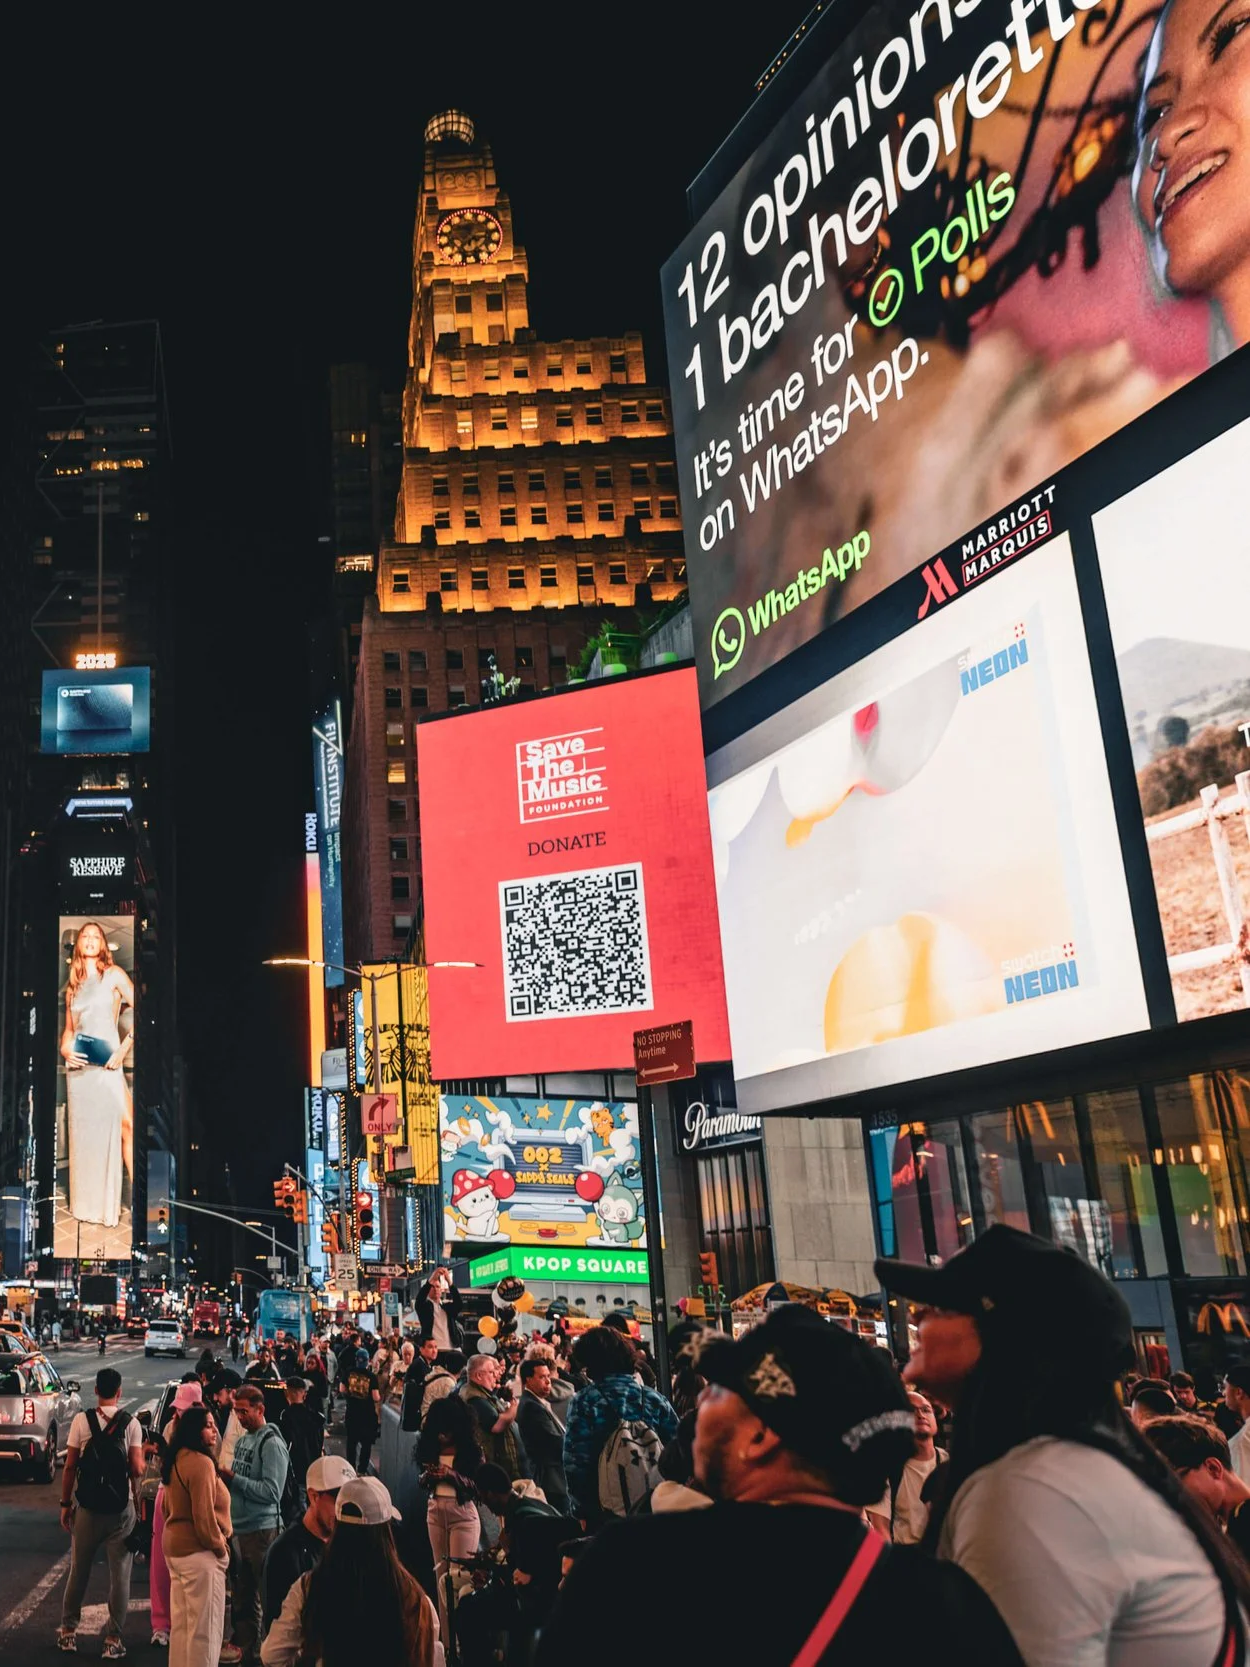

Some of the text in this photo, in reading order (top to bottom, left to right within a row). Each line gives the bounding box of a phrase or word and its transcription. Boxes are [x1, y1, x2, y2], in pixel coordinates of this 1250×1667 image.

[677, 0, 982, 328] 12 opinion
[685, 0, 1100, 411] 1 bachelorett
[910, 172, 1016, 292] Polls
[693, 315, 858, 499] It's time for
[699, 336, 930, 551] on WhatsApp.
[961, 485, 1056, 560] MARRIOTT
[964, 516, 1050, 584] MARQUIS
[747, 530, 871, 636] WhatsApp
[960, 638, 1028, 696] NEON
[526, 738, 585, 763] Save
[526, 759, 575, 781] The
[528, 774, 602, 802] Music
[529, 795, 603, 815] FOUNDATION
[528, 831, 607, 857] DONATE
[69, 857, 126, 868] SAPPHIRE
[72, 866, 124, 877] RESERVE
[1003, 960, 1079, 1004] NEON
[636, 1029, 682, 1047] NO STOPPING
[638, 1045, 666, 1061] Anytime
[368, 1122, 392, 1132] ONLY
[523, 1146, 564, 1165] 002
[338, 1269, 355, 1280] 25
[523, 1256, 572, 1272] KPOP
[576, 1258, 648, 1275] SQUARE
